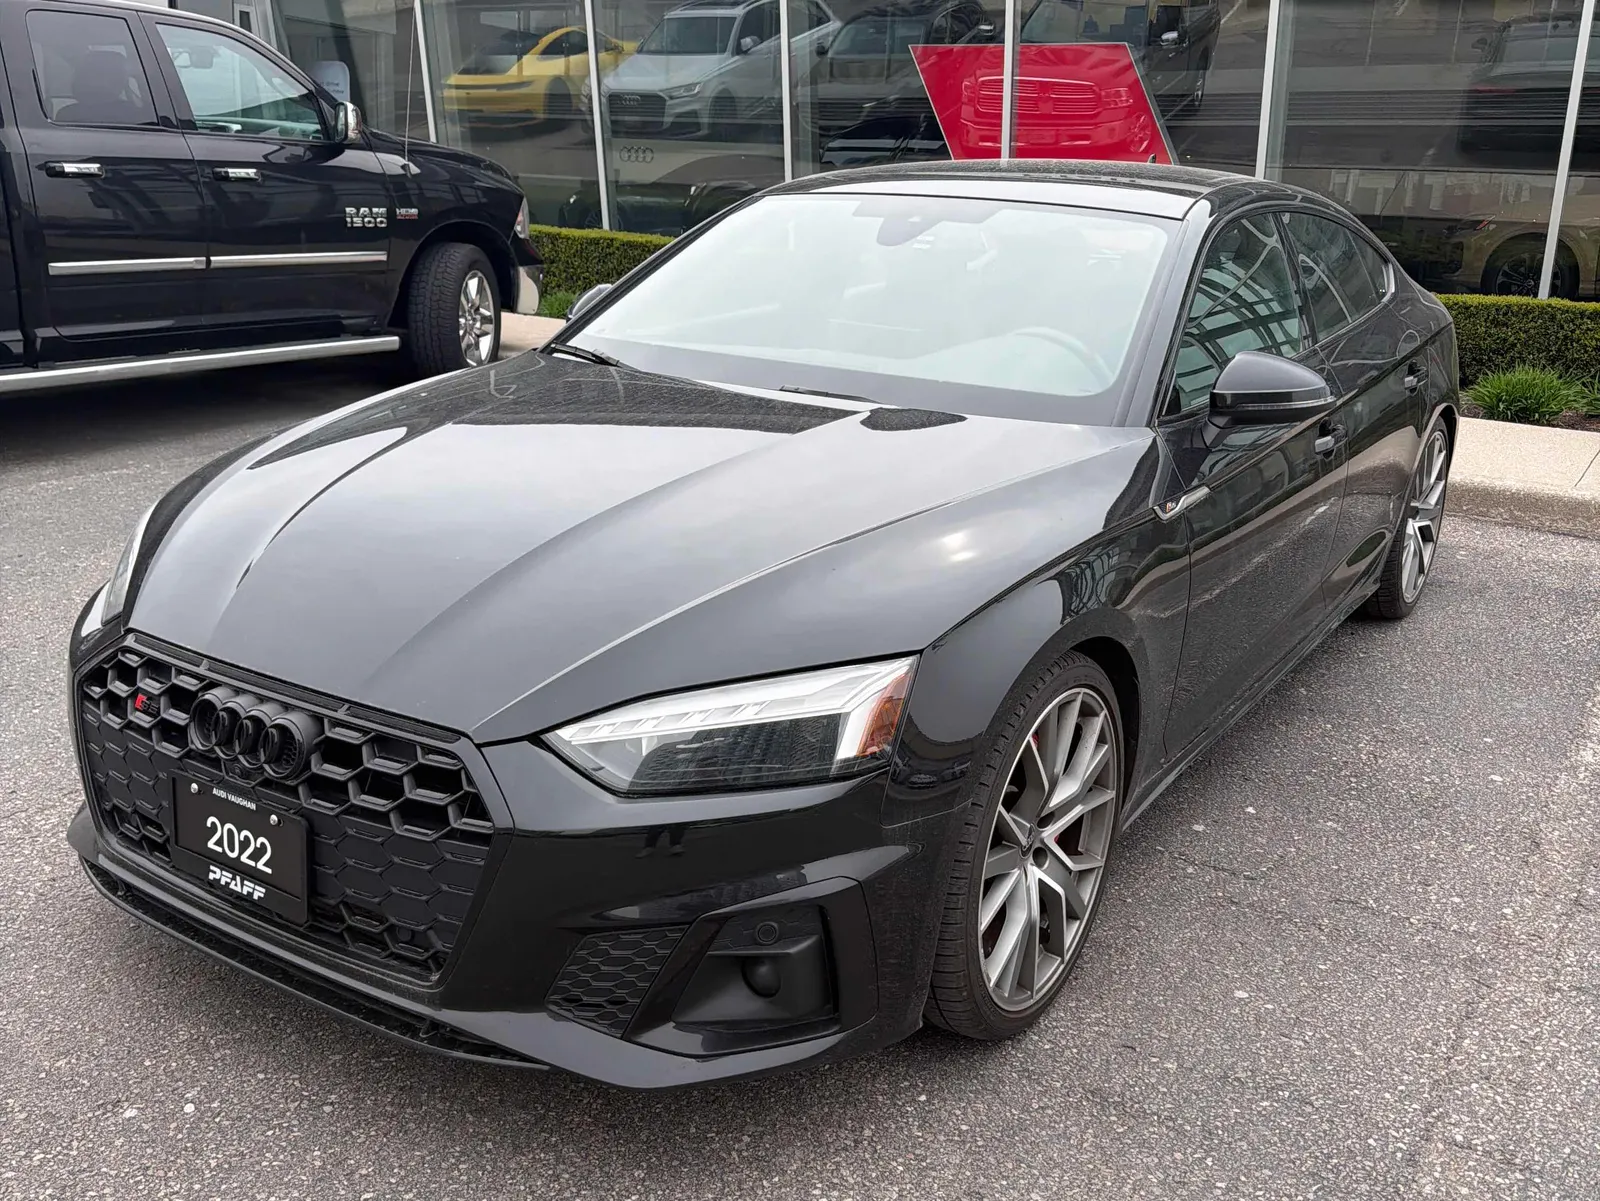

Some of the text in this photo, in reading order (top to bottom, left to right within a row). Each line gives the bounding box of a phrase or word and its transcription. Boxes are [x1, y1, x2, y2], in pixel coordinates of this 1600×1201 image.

[345, 207, 387, 217] RAM
[345, 218, 387, 227] 1500
[212, 787, 256, 811] AUDI VAUGHAN
[206, 816, 272, 874] 2022
[208, 865, 266, 900] PFAFF
